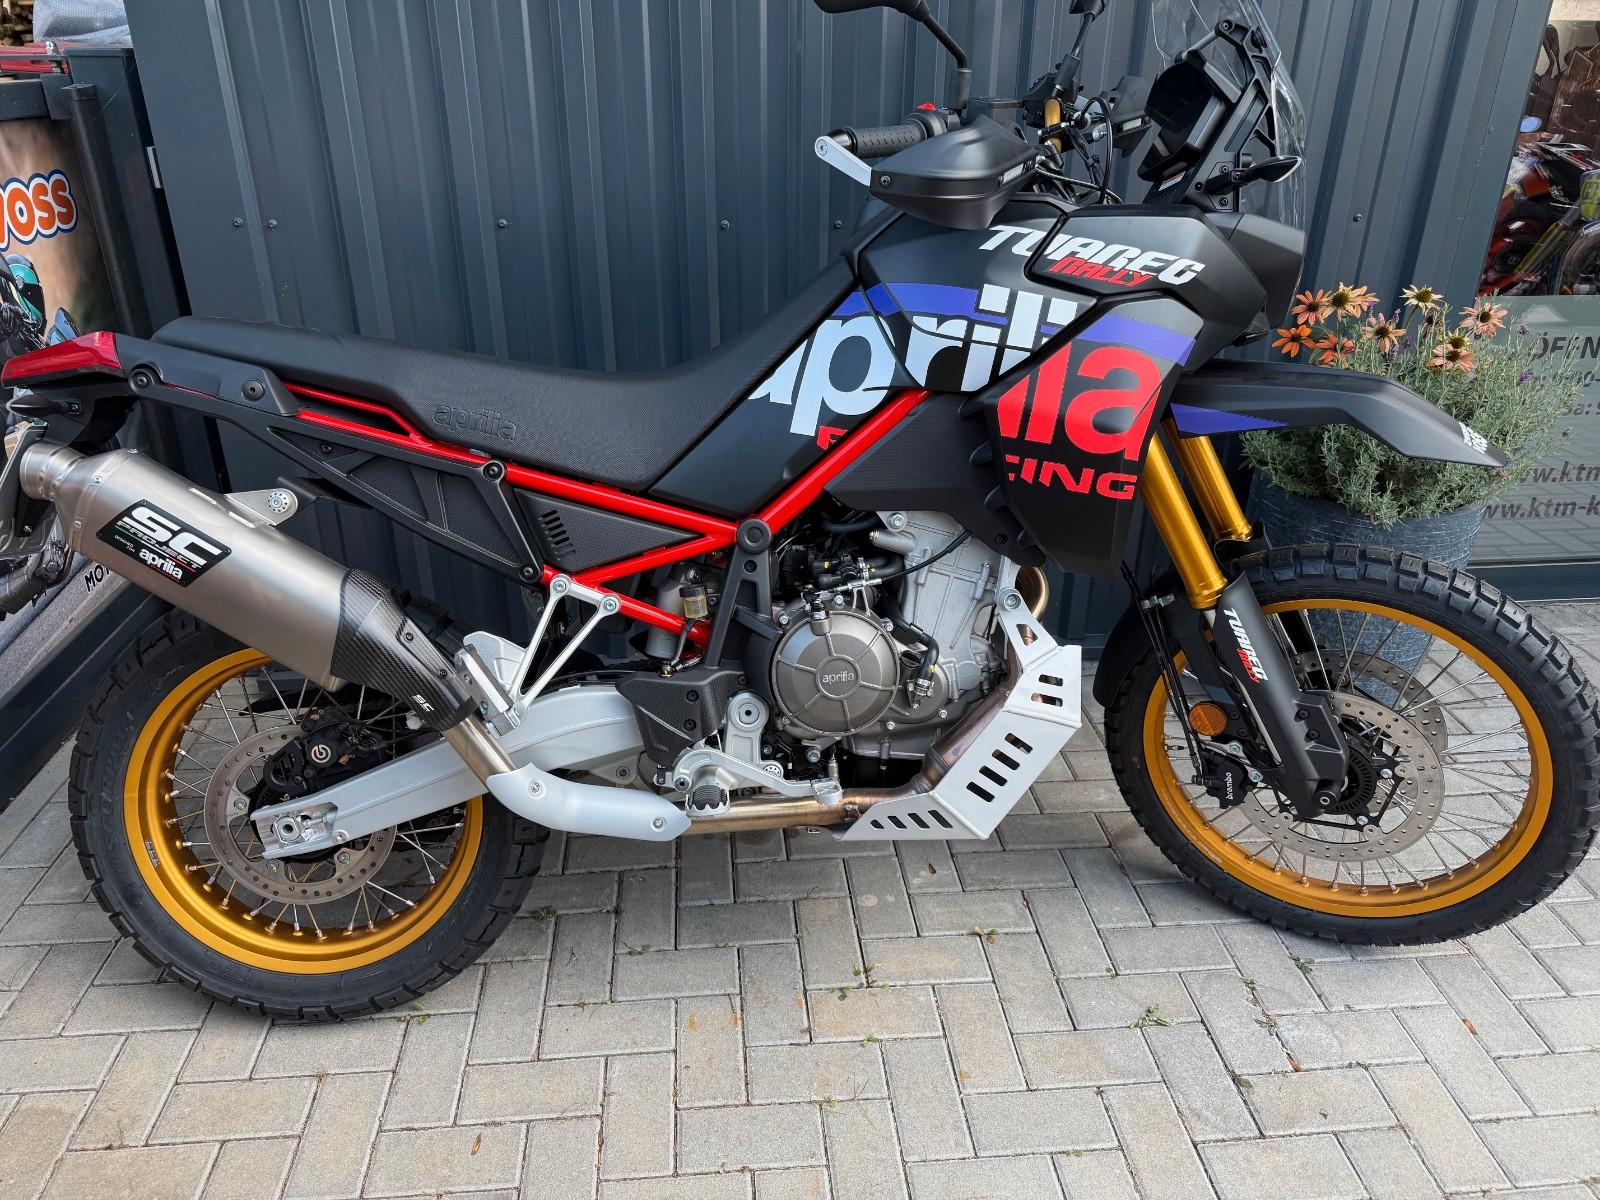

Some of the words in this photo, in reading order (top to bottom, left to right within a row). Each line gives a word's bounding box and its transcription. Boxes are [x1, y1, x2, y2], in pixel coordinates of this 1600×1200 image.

[0, 171, 77, 248] OSS
[979, 225, 1206, 285] TUAREG
[1049, 257, 1154, 287] RALLY
[432, 405, 517, 441] aprilia
[122, 506, 223, 566] SC
[85, 564, 110, 592] MO
[139, 548, 183, 580] aprilia
[822, 670, 855, 685] aprilia
[1224, 772, 1234, 800] brembo
